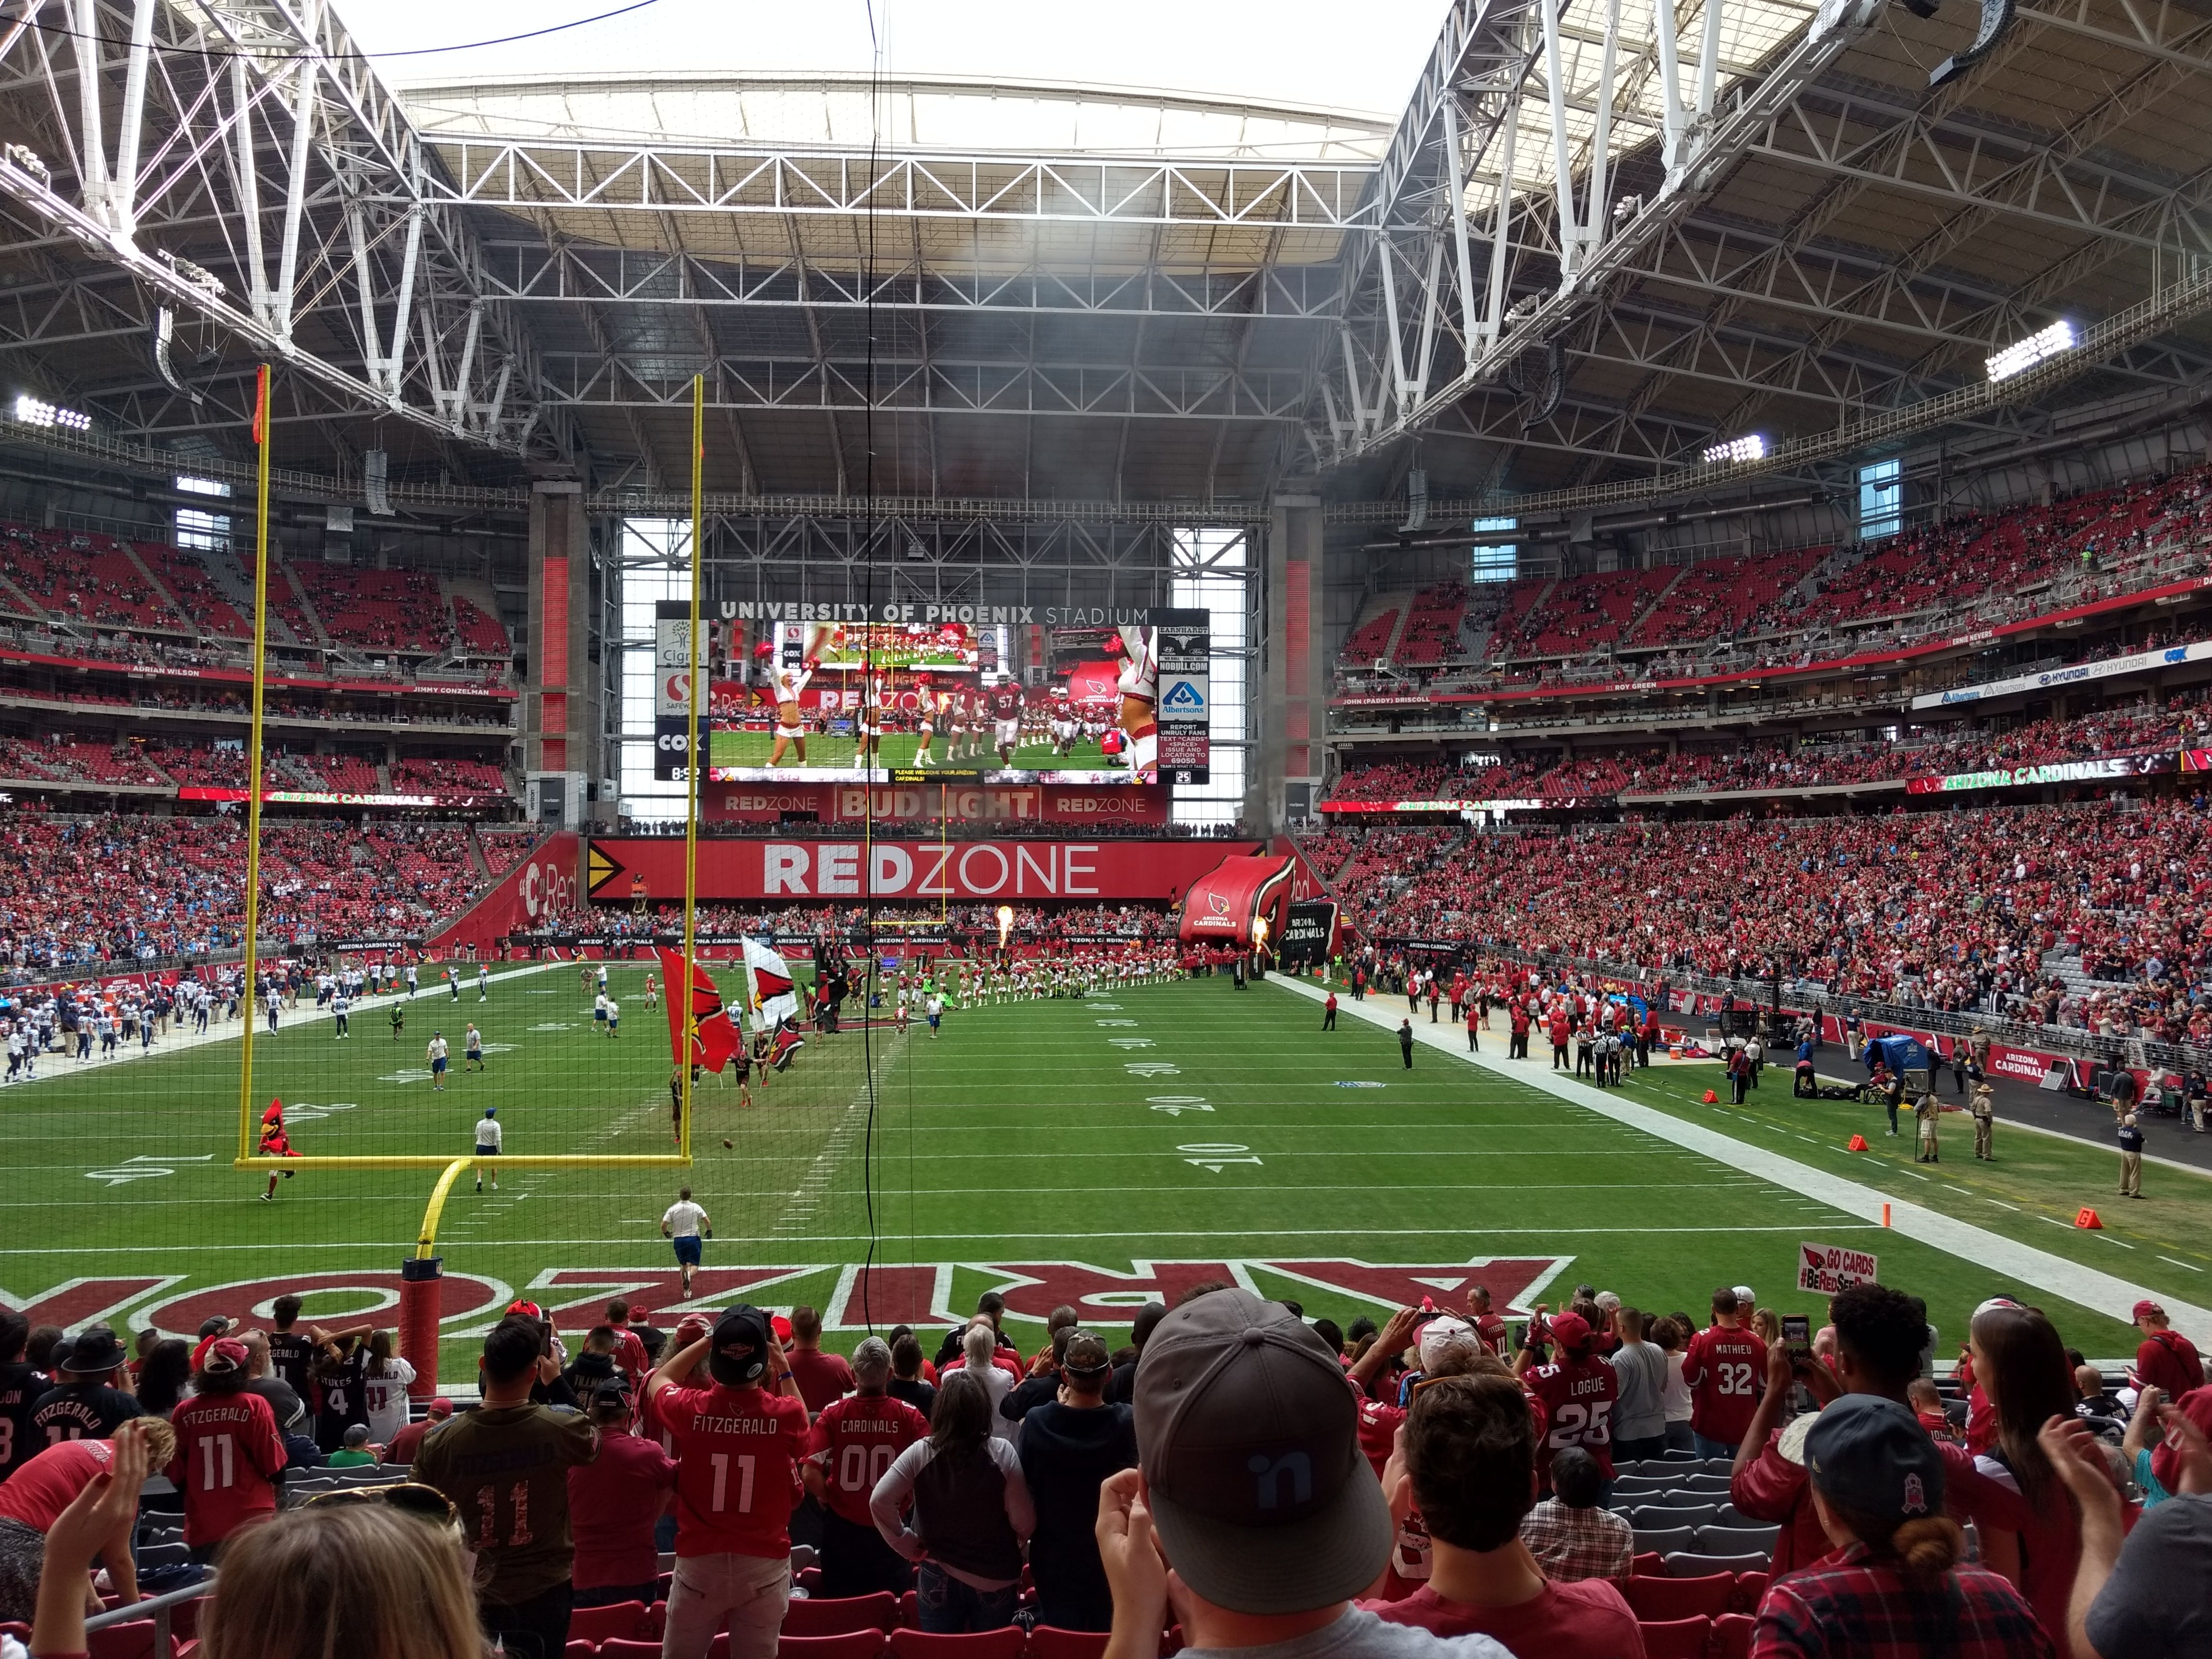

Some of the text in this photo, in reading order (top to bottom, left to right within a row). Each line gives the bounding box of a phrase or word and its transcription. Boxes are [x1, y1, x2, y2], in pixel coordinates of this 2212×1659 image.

[2193, 579, 2201, 588] 72
[721, 601, 1148, 625] UNIVERSITY OF PHOENIX STADIUM
[1953, 636, 1969, 645] ERNIE
[1970, 630, 1992, 641] NEVERS
[2164, 646, 2188, 663] COX
[1160, 662, 1207, 671] NOBULL.COM
[2107, 657, 2147, 673] HYUNDAI
[2053, 667, 2089, 684] HYUNDAI
[1951, 691, 1980, 703] Albertsons
[1995, 682, 2026, 695] Albertsons
[998, 696, 1013, 709] 57
[1058, 703, 1070, 713] 94
[659, 733, 703, 753] COX
[1178, 773, 1189, 782] 25
[1946, 758, 2122, 790] ARIZONA CARDINALS
[273, 793, 438, 805] ARIZONA CARDINALS
[726, 796, 817, 811] REDZONE
[842, 791, 920, 817] BUD
[1057, 798, 1146, 812] REDZONE
[1398, 799, 1541, 810] ARIZONA CARDINALS
[764, 845, 1099, 894] REDZONE
[1292, 917, 1316, 927] ARIZONA
[1286, 927, 1324, 940] CARDINALS
[1124, 1062, 1181, 1074] 30
[2006, 1053, 2039, 1066] ARIZONA
[1995, 1059, 2050, 1078] CARDINALS
[1145, 1095, 1215, 1112] 20
[1176, 1143, 1263, 1166] 10
[1827, 1249, 1874, 1276] GO CARDS
[271, 1349, 300, 1358] GERALD
[1716, 1344, 1752, 1355] MATHIEU
[1570, 1376, 1605, 1396] LOGUE
[1718, 1362, 1753, 1395] 32
[328, 1389, 349, 1416] 4
[366, 1387, 387, 1412] 11
[34, 1401, 102, 1430] FITZGERALD
[182, 1407, 250, 1428] FITZGERALD
[2075, 1404, 2093, 1415] 24
[693, 1415, 777, 1435] FITZGERALD
[842, 1419, 899, 1433] CARDINALS
[1549, 1401, 1612, 1449] 25
[199, 1433, 234, 1491] 11
[840, 1444, 896, 1491] 00
[711, 1453, 756, 1513] 11
[475, 1479, 533, 1548] 11
